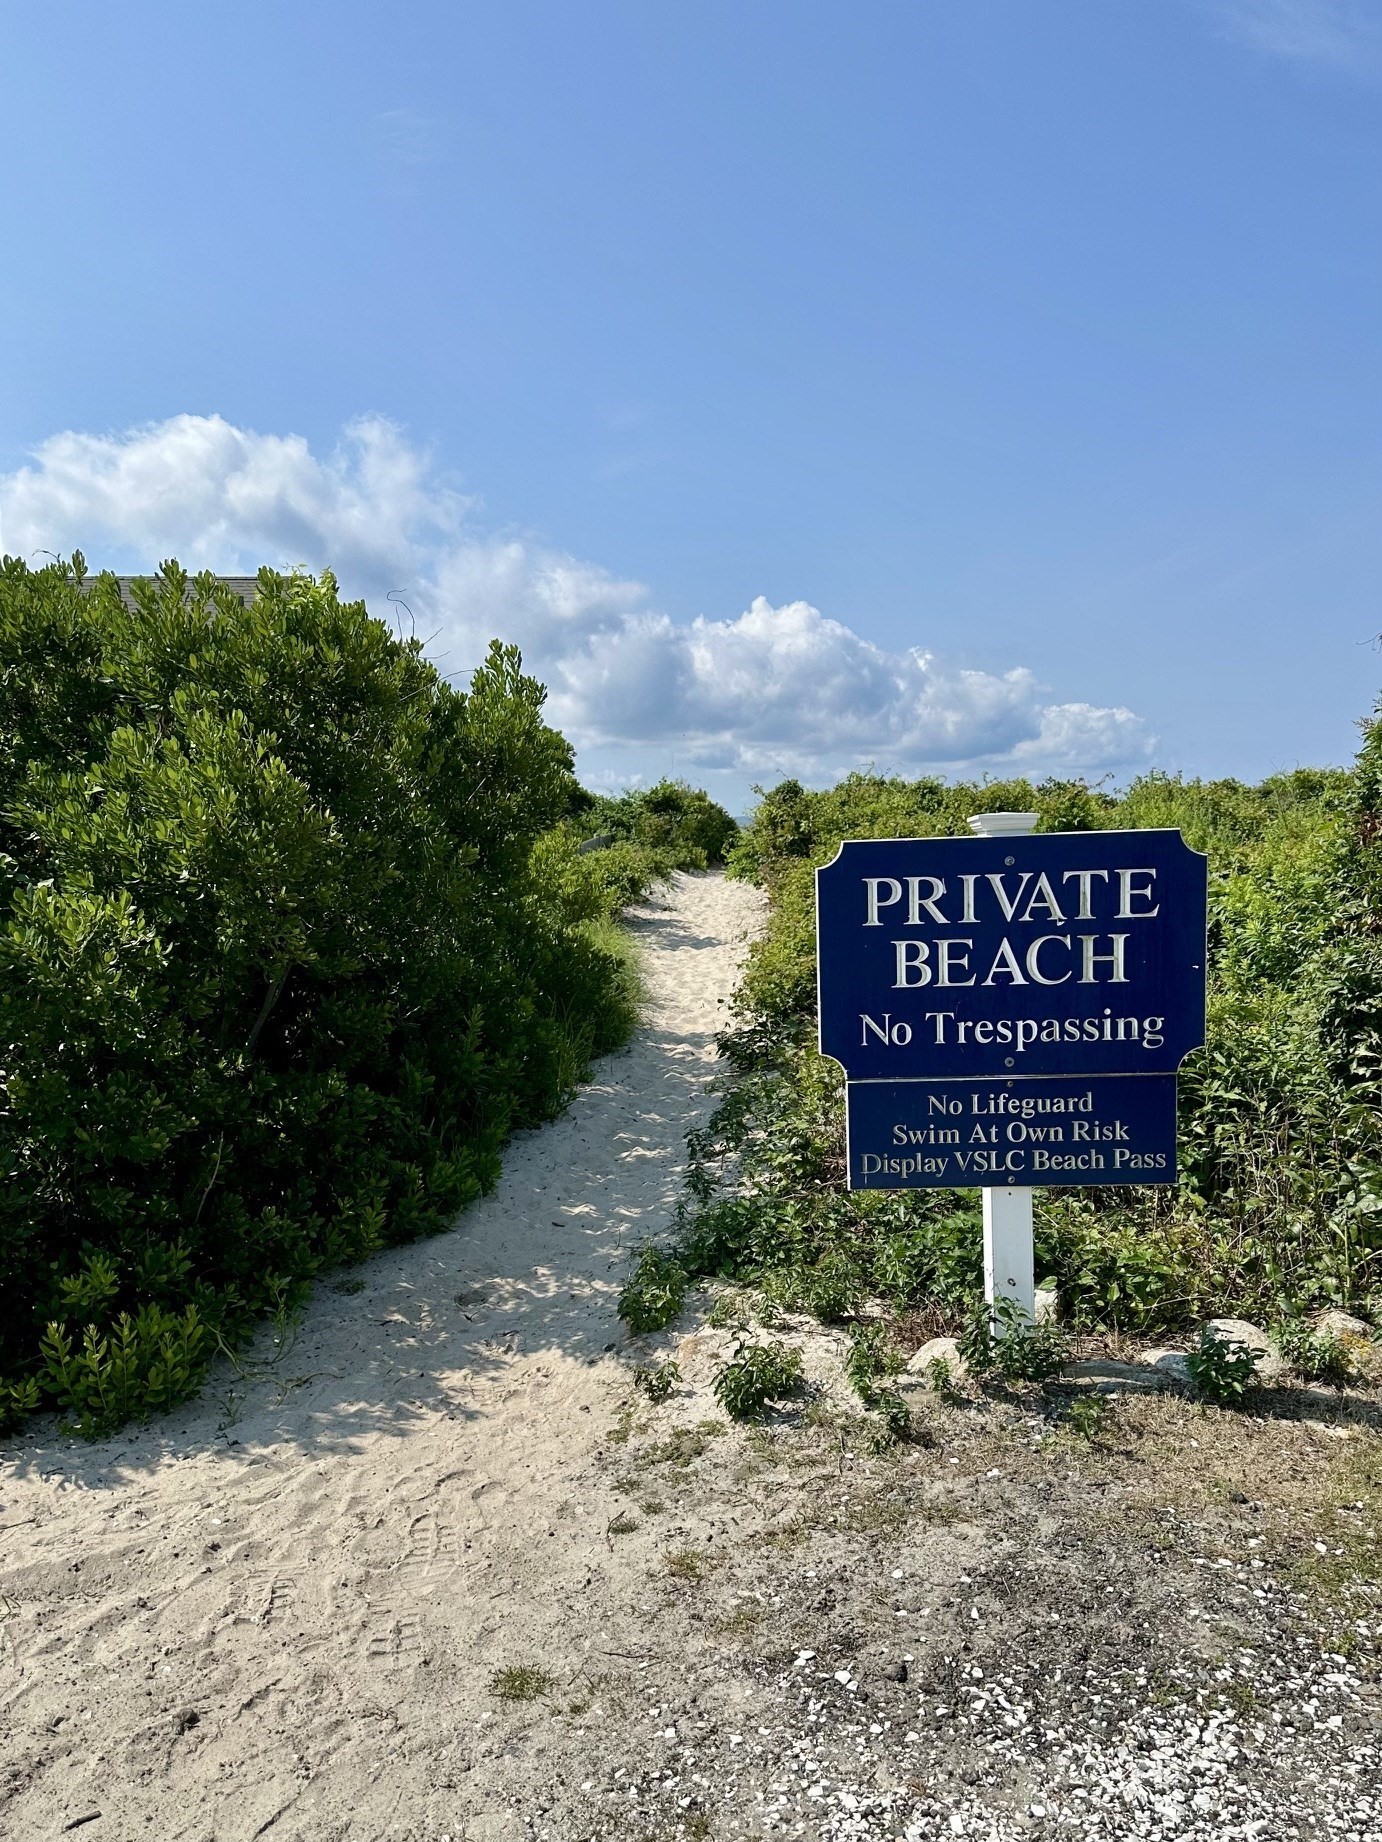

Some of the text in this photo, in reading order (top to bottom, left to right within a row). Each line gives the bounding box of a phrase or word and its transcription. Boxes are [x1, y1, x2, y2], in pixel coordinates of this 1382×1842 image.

[862, 869, 1159, 926] PRIVATE
[891, 934, 1130, 988] BEACH
[859, 1008, 1164, 1051] No Trespassing
[928, 1092, 1093, 1116] No Lifeguard
[894, 1120, 1129, 1145] Swim At Own Risk
[861, 1149, 1166, 1178] Display VSLC Beach Pass
